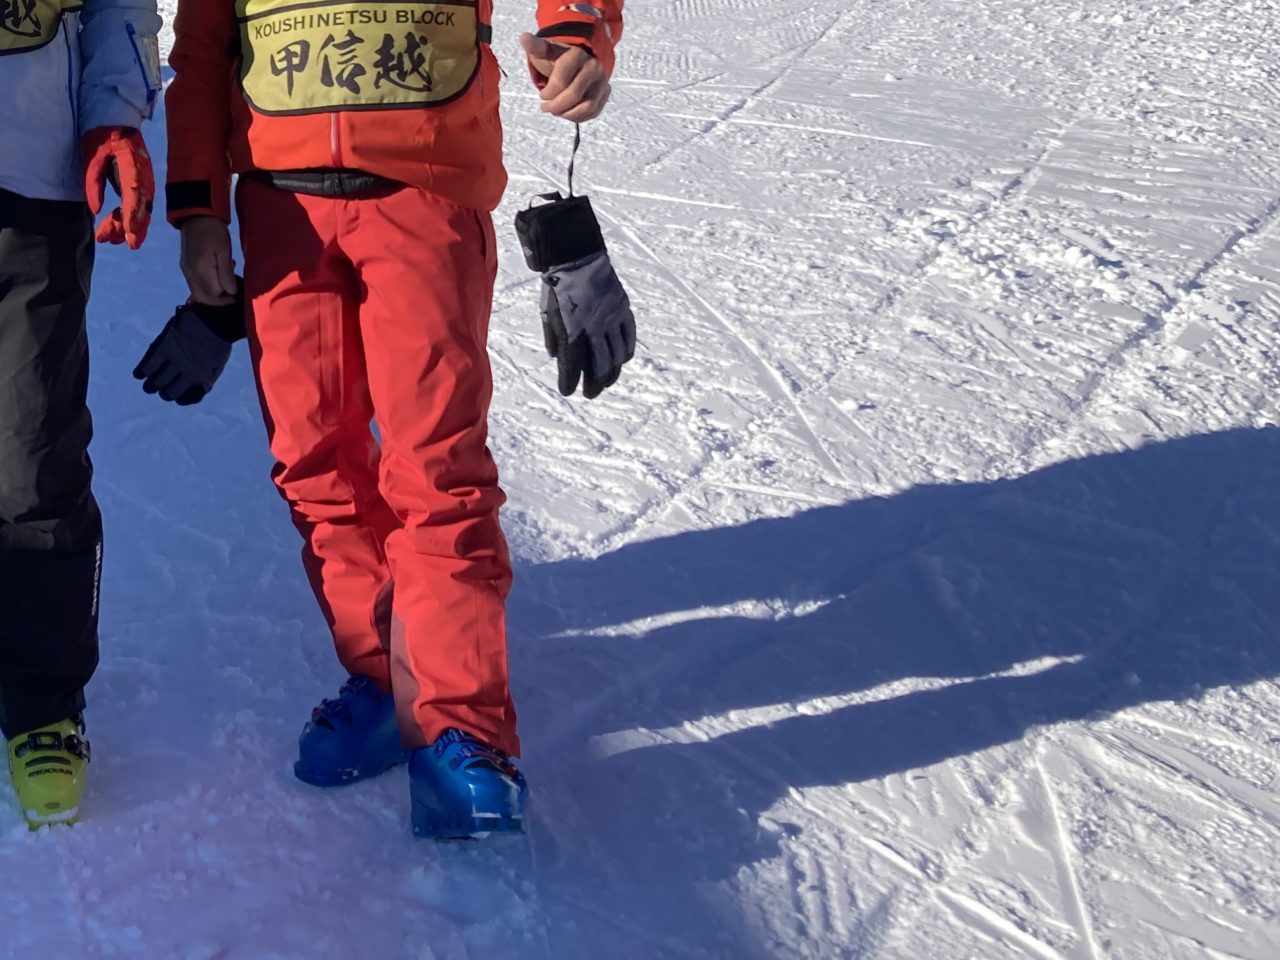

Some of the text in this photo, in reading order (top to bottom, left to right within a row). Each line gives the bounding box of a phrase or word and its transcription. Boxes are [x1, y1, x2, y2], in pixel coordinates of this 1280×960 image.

[255, 10, 456, 40] KOUSHINETSU BLOCK
[270, 29, 433, 98] 甲信越
